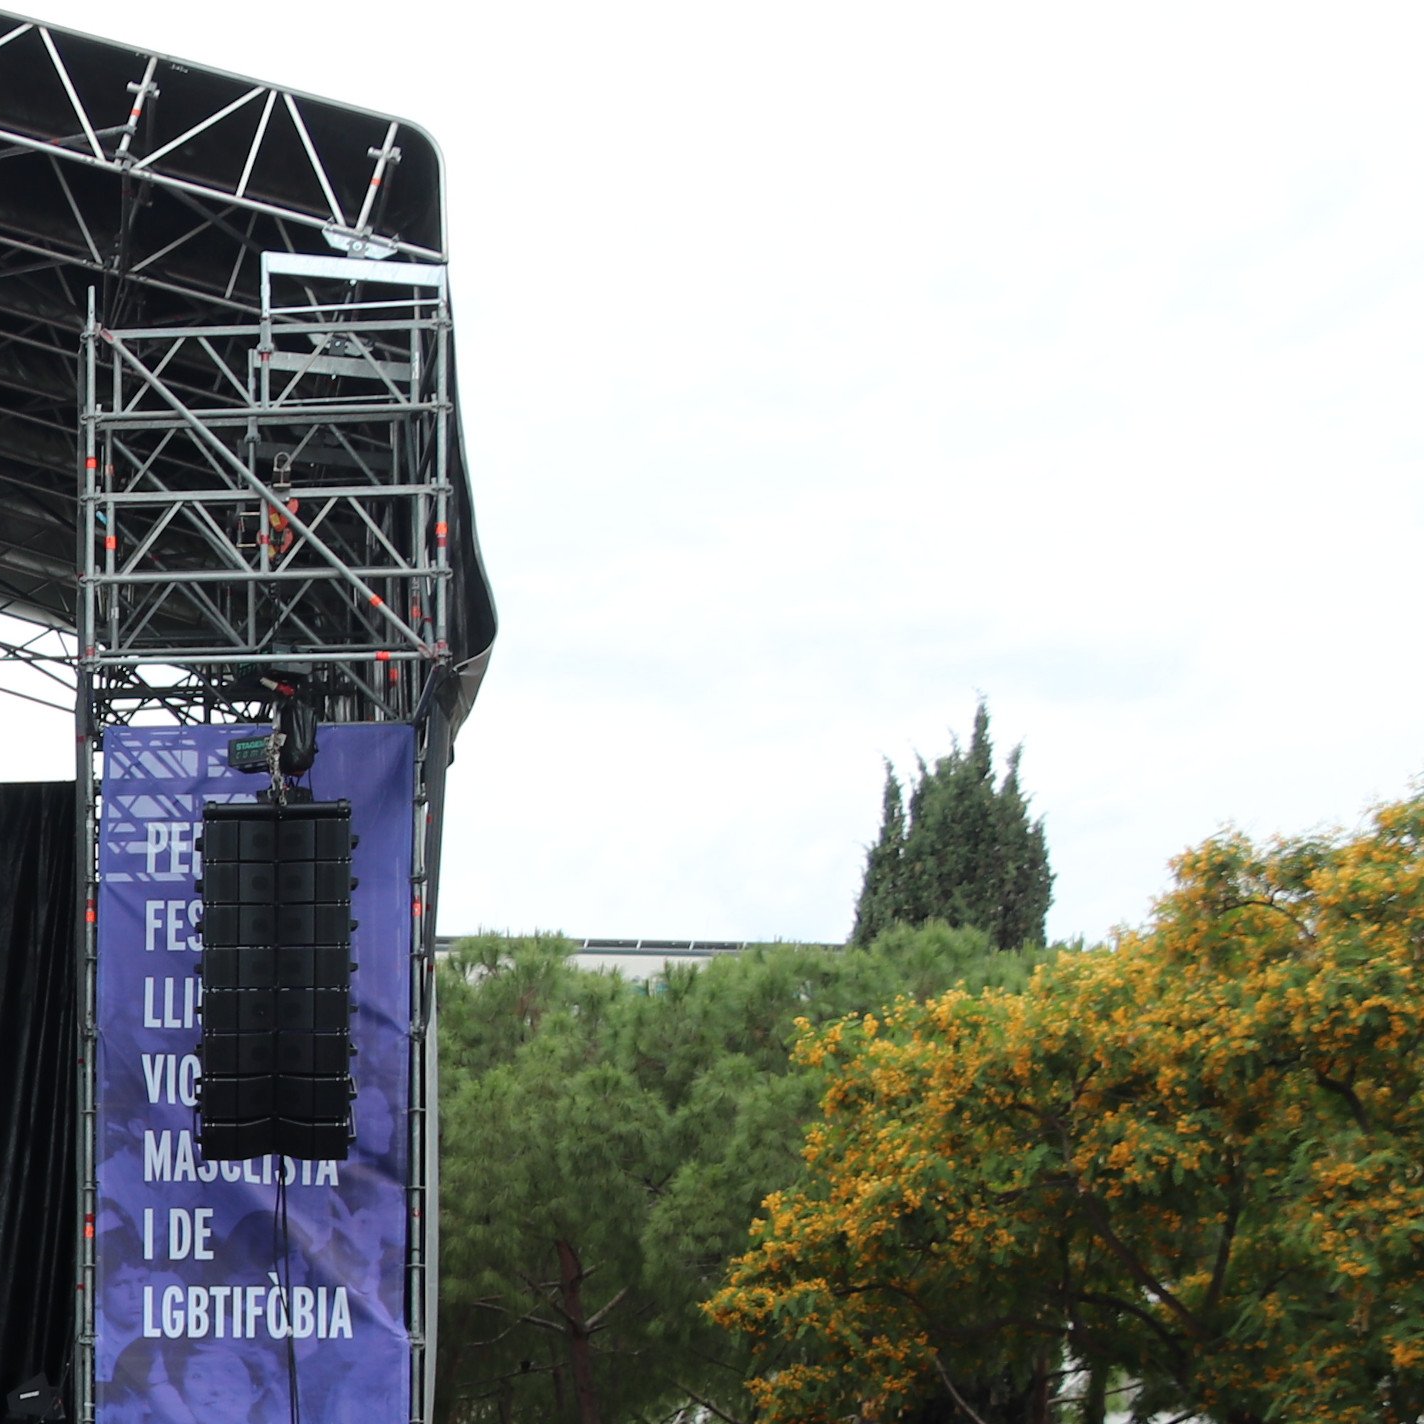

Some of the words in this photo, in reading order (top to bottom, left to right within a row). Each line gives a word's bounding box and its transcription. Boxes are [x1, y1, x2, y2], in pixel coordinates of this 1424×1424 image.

[144, 1208, 154, 1260] I
[169, 1208, 214, 1260] DE
[143, 1272, 353, 1339] LGBTIFÒBIA
